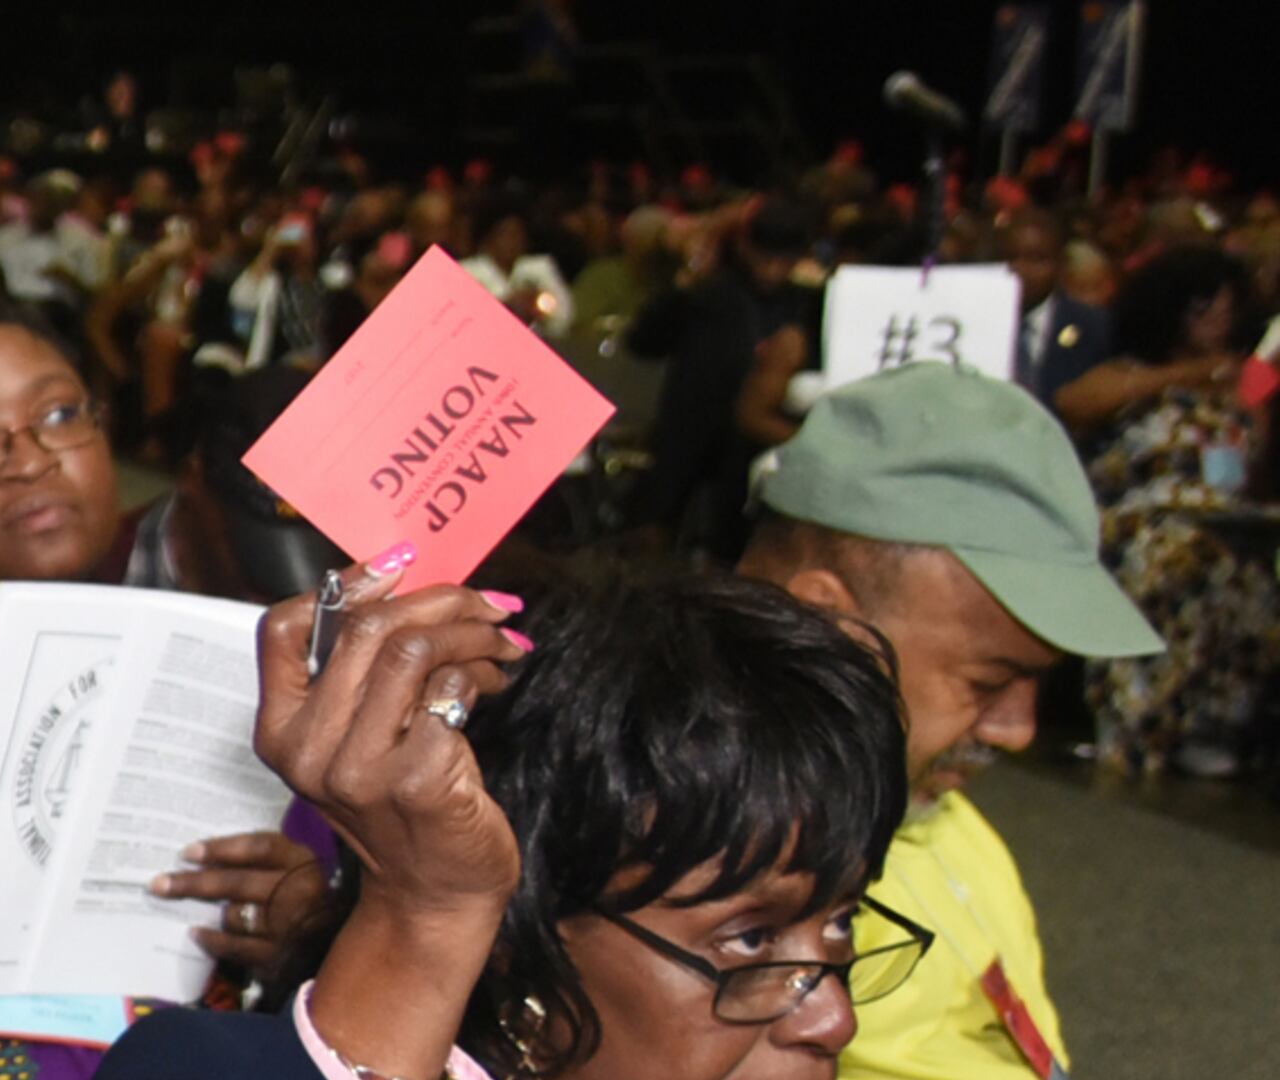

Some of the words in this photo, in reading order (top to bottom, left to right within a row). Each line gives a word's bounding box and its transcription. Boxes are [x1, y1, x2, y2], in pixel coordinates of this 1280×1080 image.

[875, 312, 962, 373] #3
[370, 365, 501, 499] VOTING
[393, 451, 457, 520] CONVENTION
[427, 400, 538, 533] NAACP
[16, 704, 62, 808] ASSOCIATION
[68, 670, 97, 699] FOR
